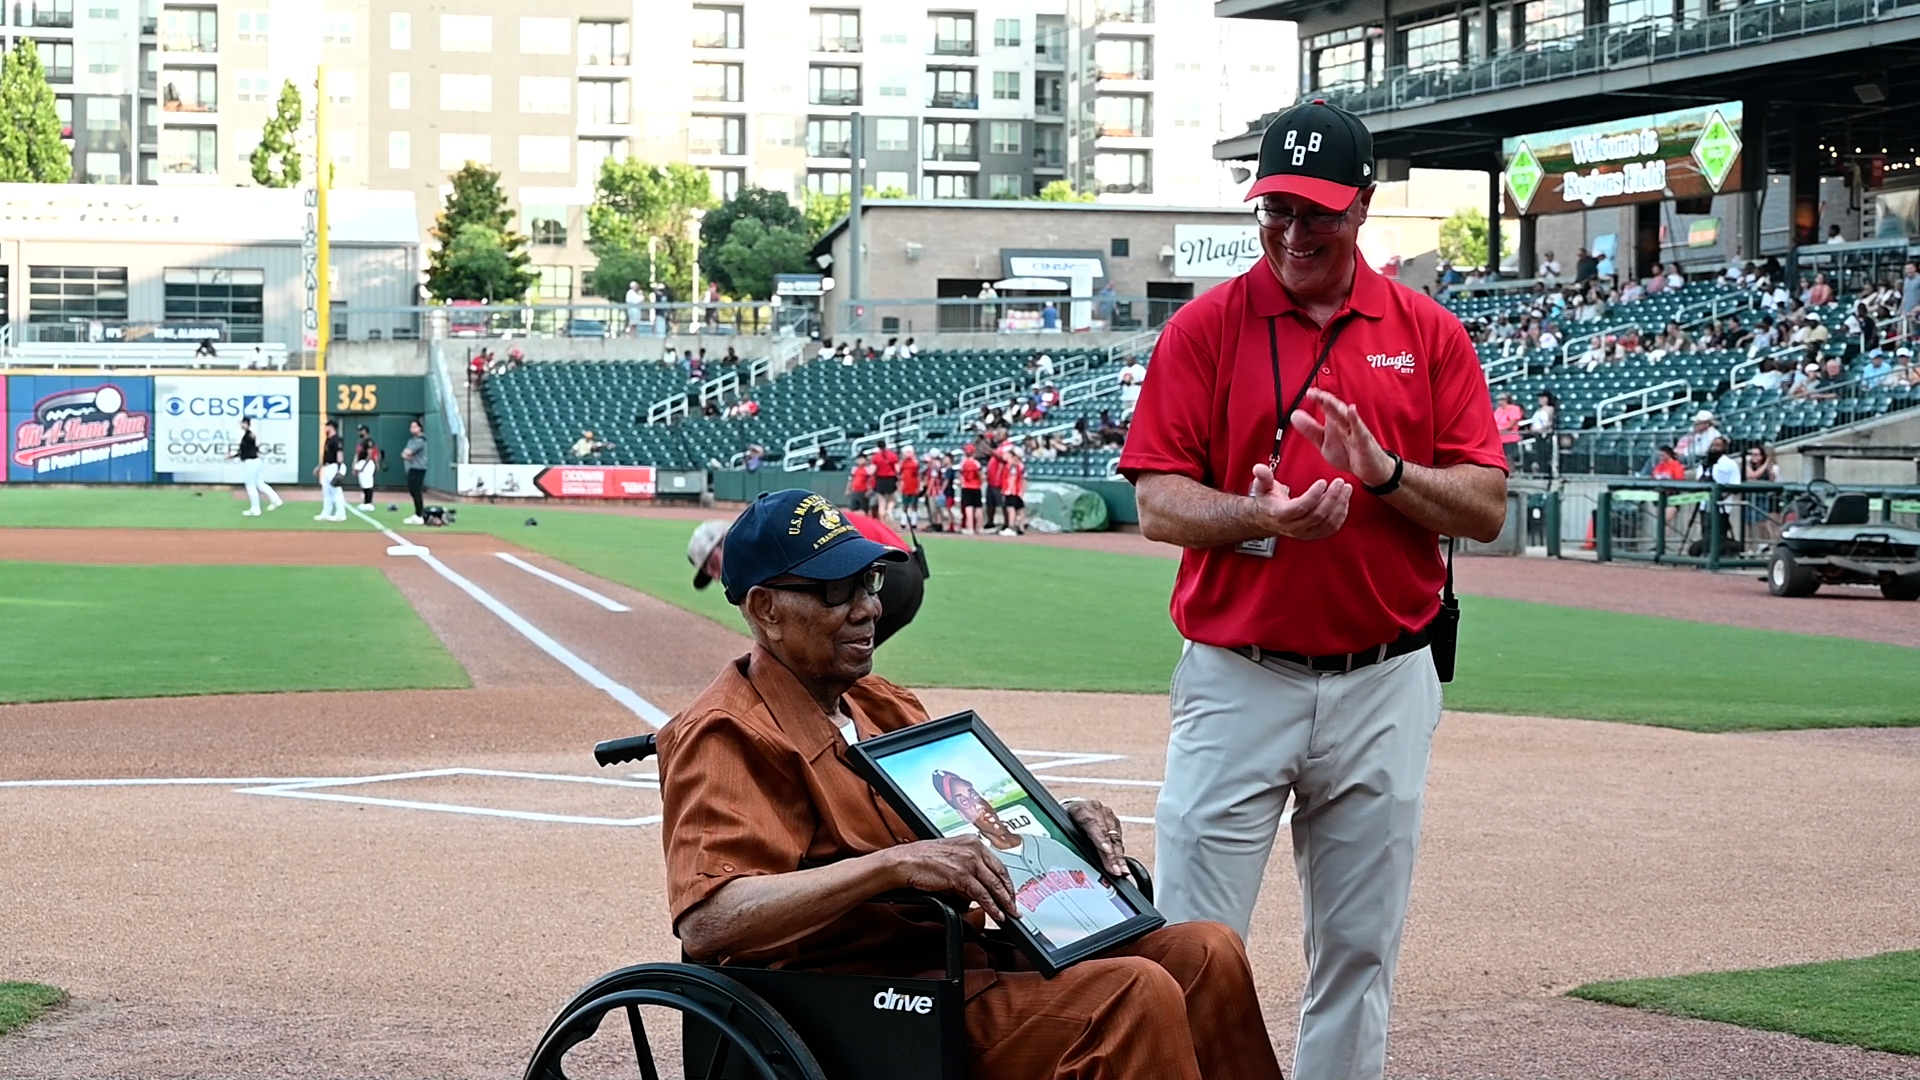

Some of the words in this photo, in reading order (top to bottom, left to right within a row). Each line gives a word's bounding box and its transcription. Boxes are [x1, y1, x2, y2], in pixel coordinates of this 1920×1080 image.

[1571, 133, 1640, 164] Welcome
[1640, 128, 1659, 154] to
[1564, 169, 1624, 204] Regions
[1624, 160, 1666, 193] Field
[1180, 231, 1260, 267] Magic
[1366, 350, 1415, 370] Magic
[189, 397, 240, 416] CBS
[243, 395, 291, 419] 42
[336, 384, 378, 411] 325
[167, 443, 287, 455] COVERGE
[168, 429, 237, 442] LOCAL
[873, 987, 933, 1014] drive
